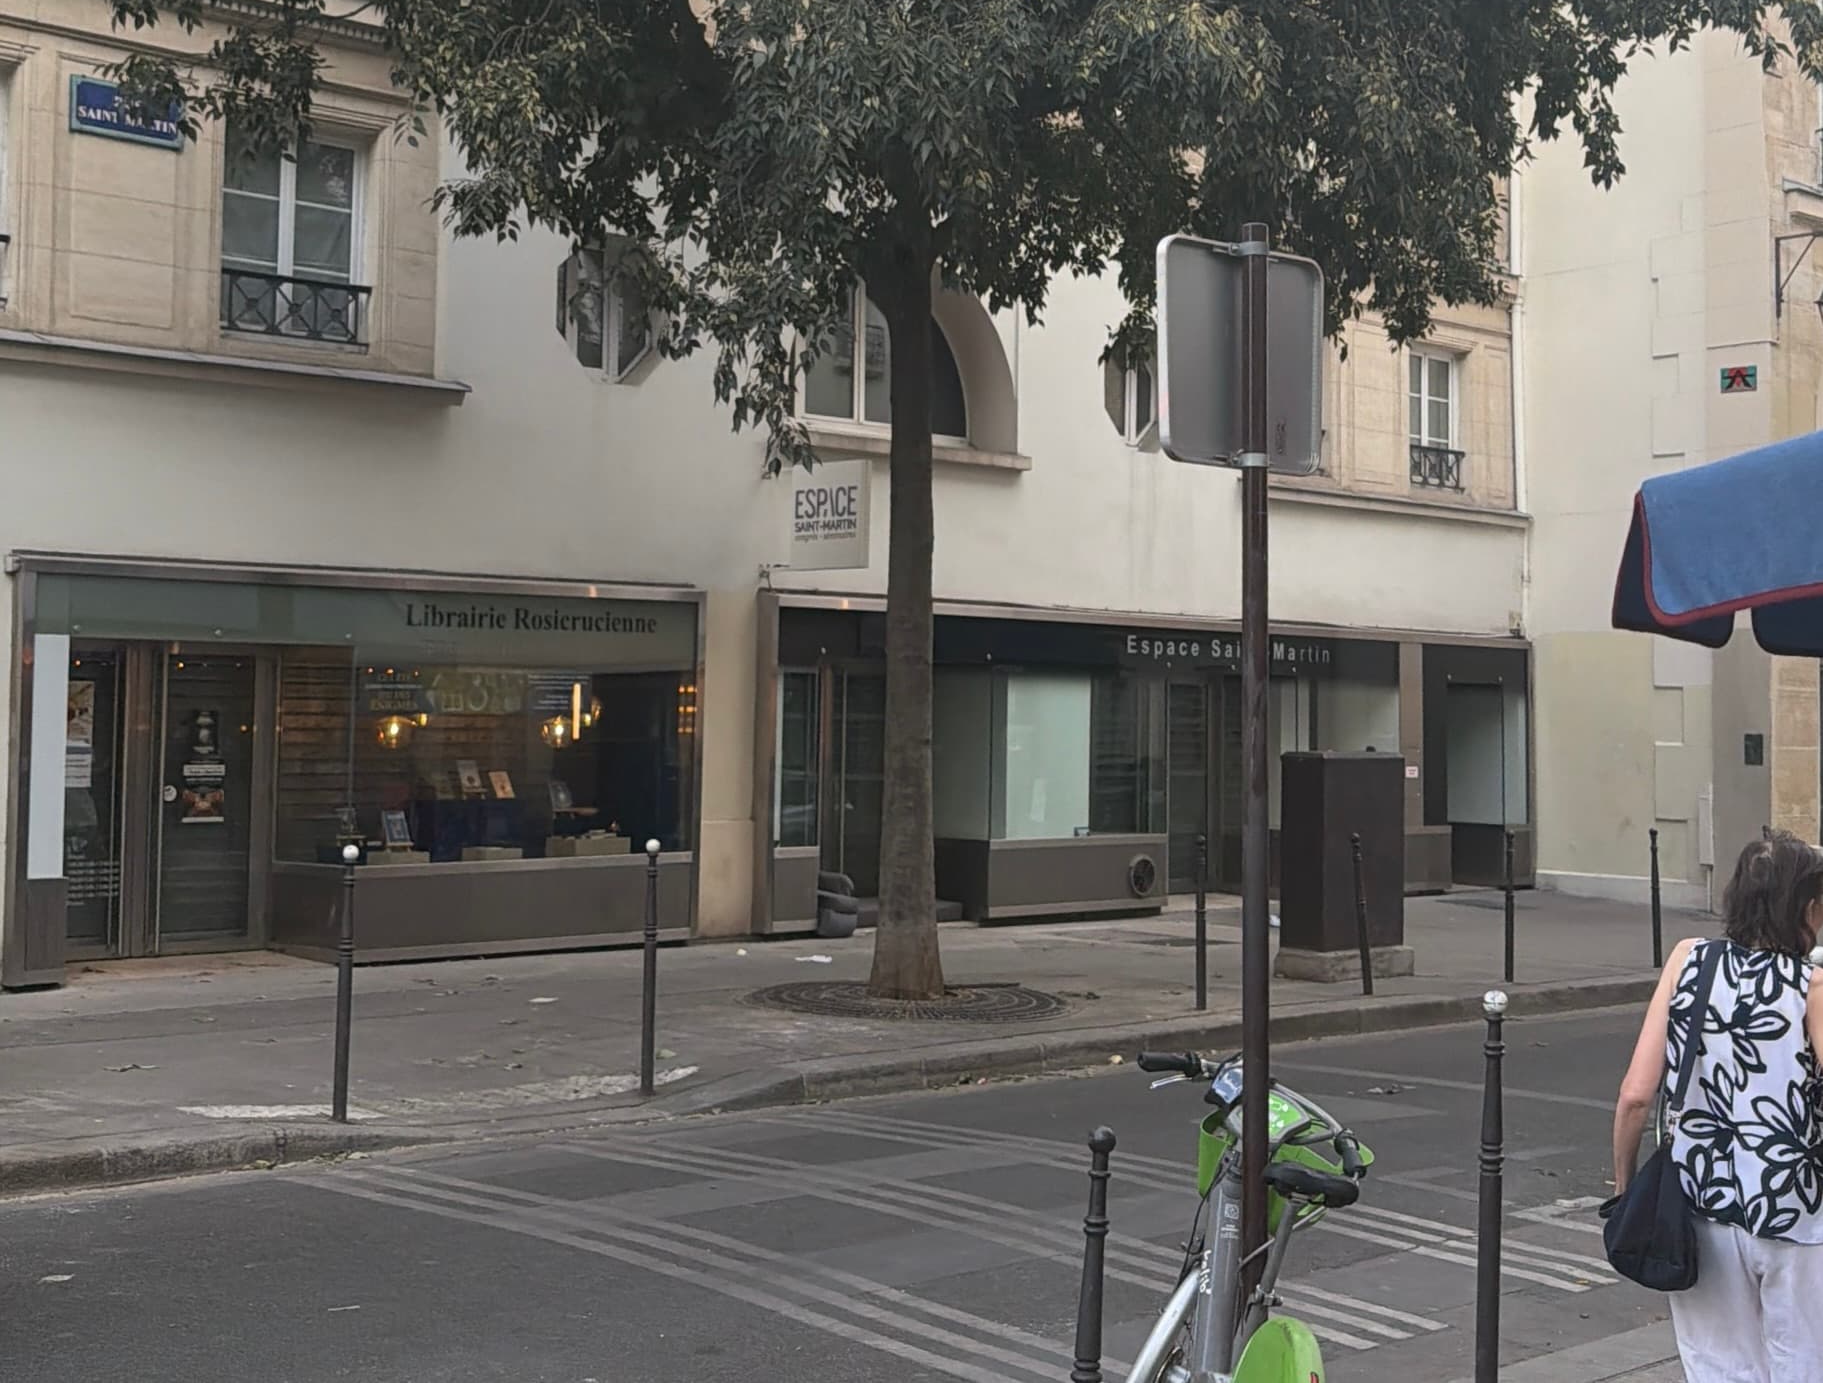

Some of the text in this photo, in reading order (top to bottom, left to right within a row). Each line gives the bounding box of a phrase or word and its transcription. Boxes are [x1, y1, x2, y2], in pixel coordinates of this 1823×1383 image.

[78, 105, 118, 124] SAINT
[795, 485, 858, 520] ESPACE
[794, 518, 857, 533] SAINT-MARTIN
[406, 603, 657, 634] Librairie Rosicrucienne
[1127, 634, 1200, 659] Espace
